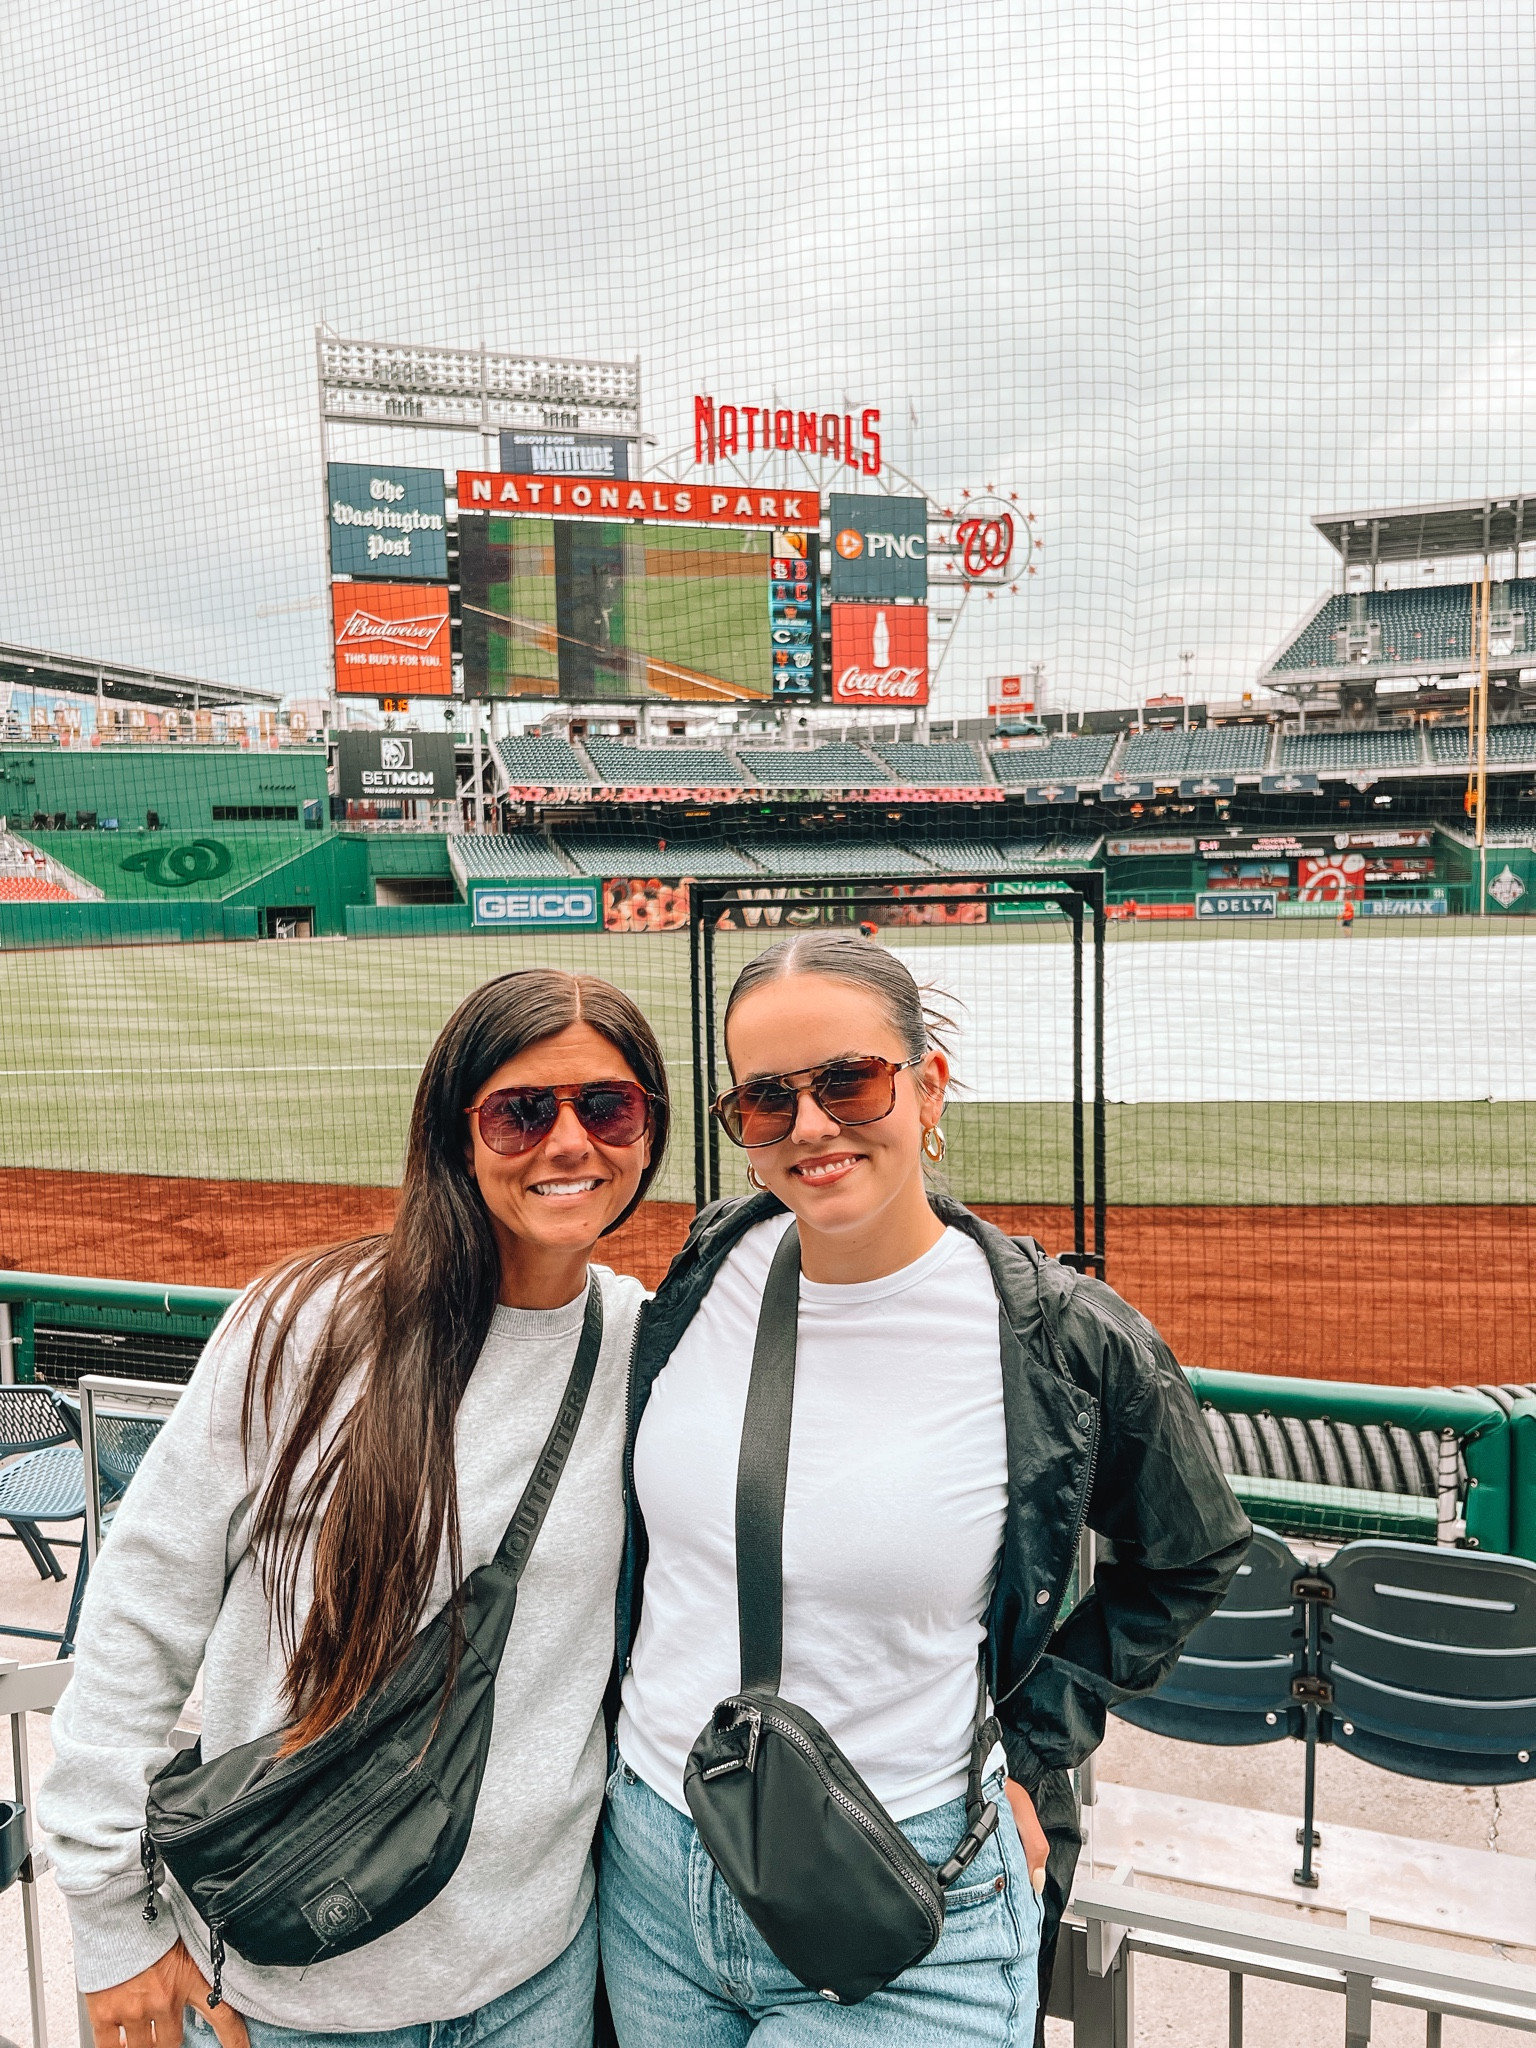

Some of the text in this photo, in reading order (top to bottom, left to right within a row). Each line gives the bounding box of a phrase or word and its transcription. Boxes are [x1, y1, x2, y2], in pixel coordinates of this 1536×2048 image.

[694, 395, 881, 476] NATIONALS
[531, 445, 615, 471] NATITUDE
[369, 478, 405, 504] The
[472, 480, 803, 519] NATIONALS PARK
[333, 500, 444, 534] Washington
[367, 534, 412, 560] Post
[864, 532, 925, 560] PNC
[344, 618, 437, 638] Budweiser
[344, 653, 367, 665] THIS
[368, 653, 398, 665] BUD'S
[400, 655, 419, 666] FOR
[837, 666, 925, 698] Coca-Cola
[361, 770, 434, 786] BETMGM
[478, 894, 593, 919] GEICO
[1217, 899, 1273, 912] DELTA
[1373, 901, 1434, 915] RE/MAX
[705, 1759, 739, 1775] lululemon
[328, 1905, 348, 1926] AE
